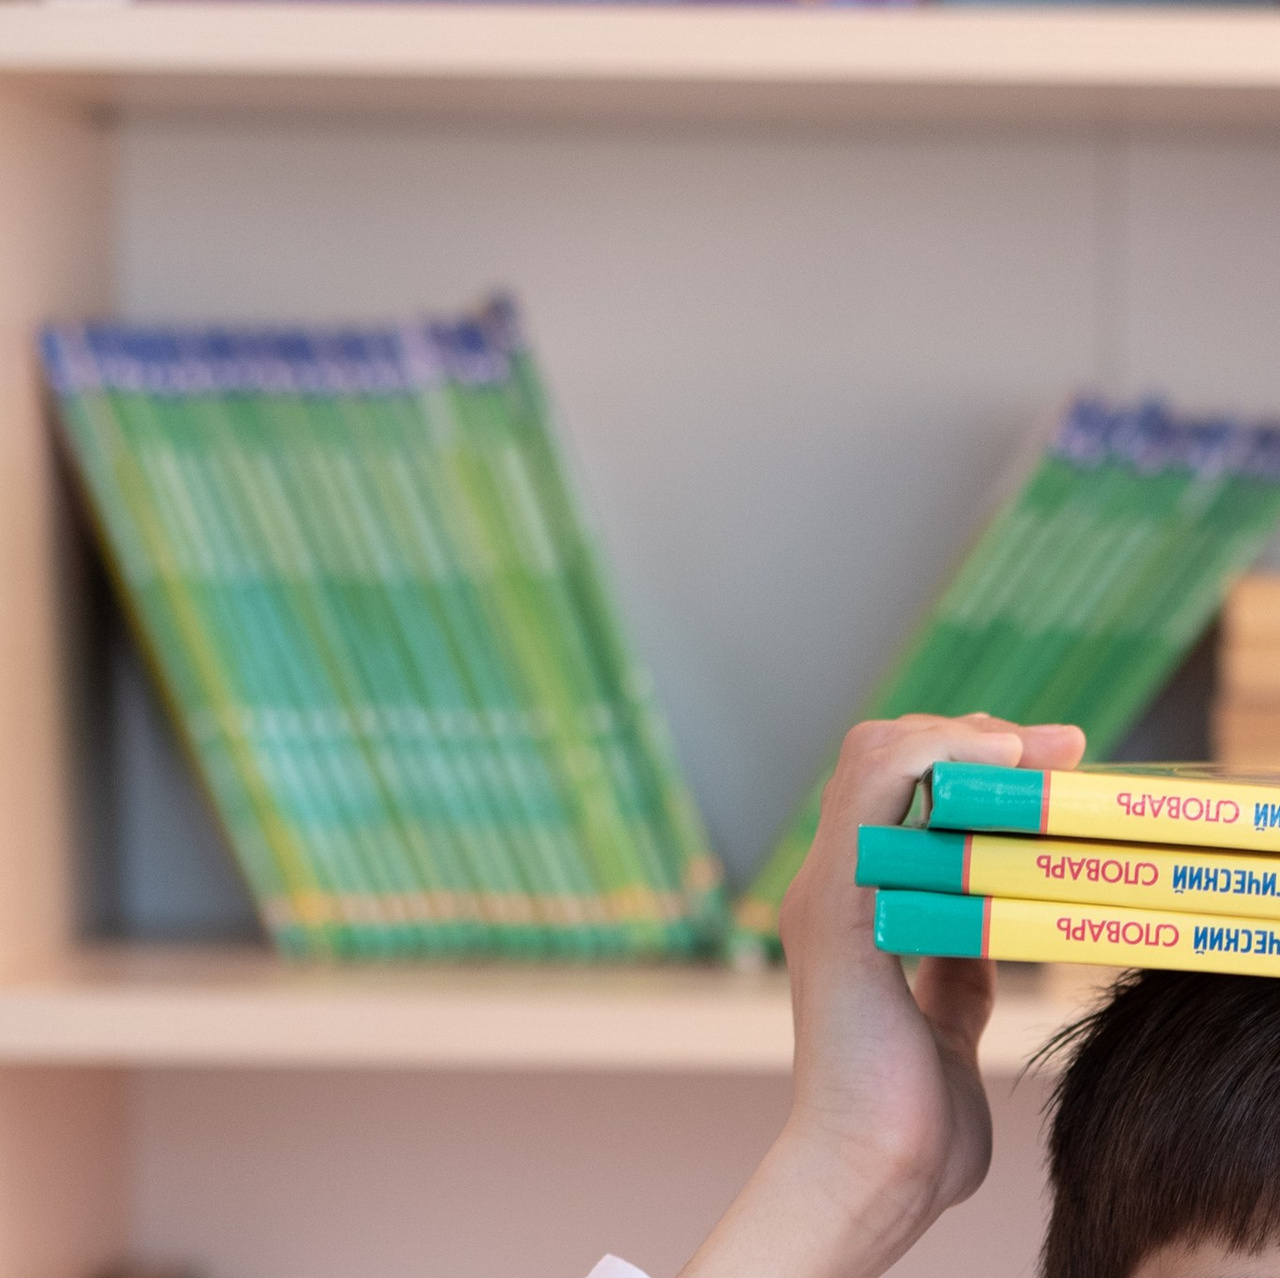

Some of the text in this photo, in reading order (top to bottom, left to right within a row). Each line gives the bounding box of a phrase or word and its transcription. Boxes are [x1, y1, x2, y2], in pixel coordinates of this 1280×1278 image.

[1116, 792, 1240, 824] СЛОВАРЬ
[1036, 854, 1159, 886] СЛОВАРЬ
[1056, 917, 1180, 948] СЛОВАРЬ
